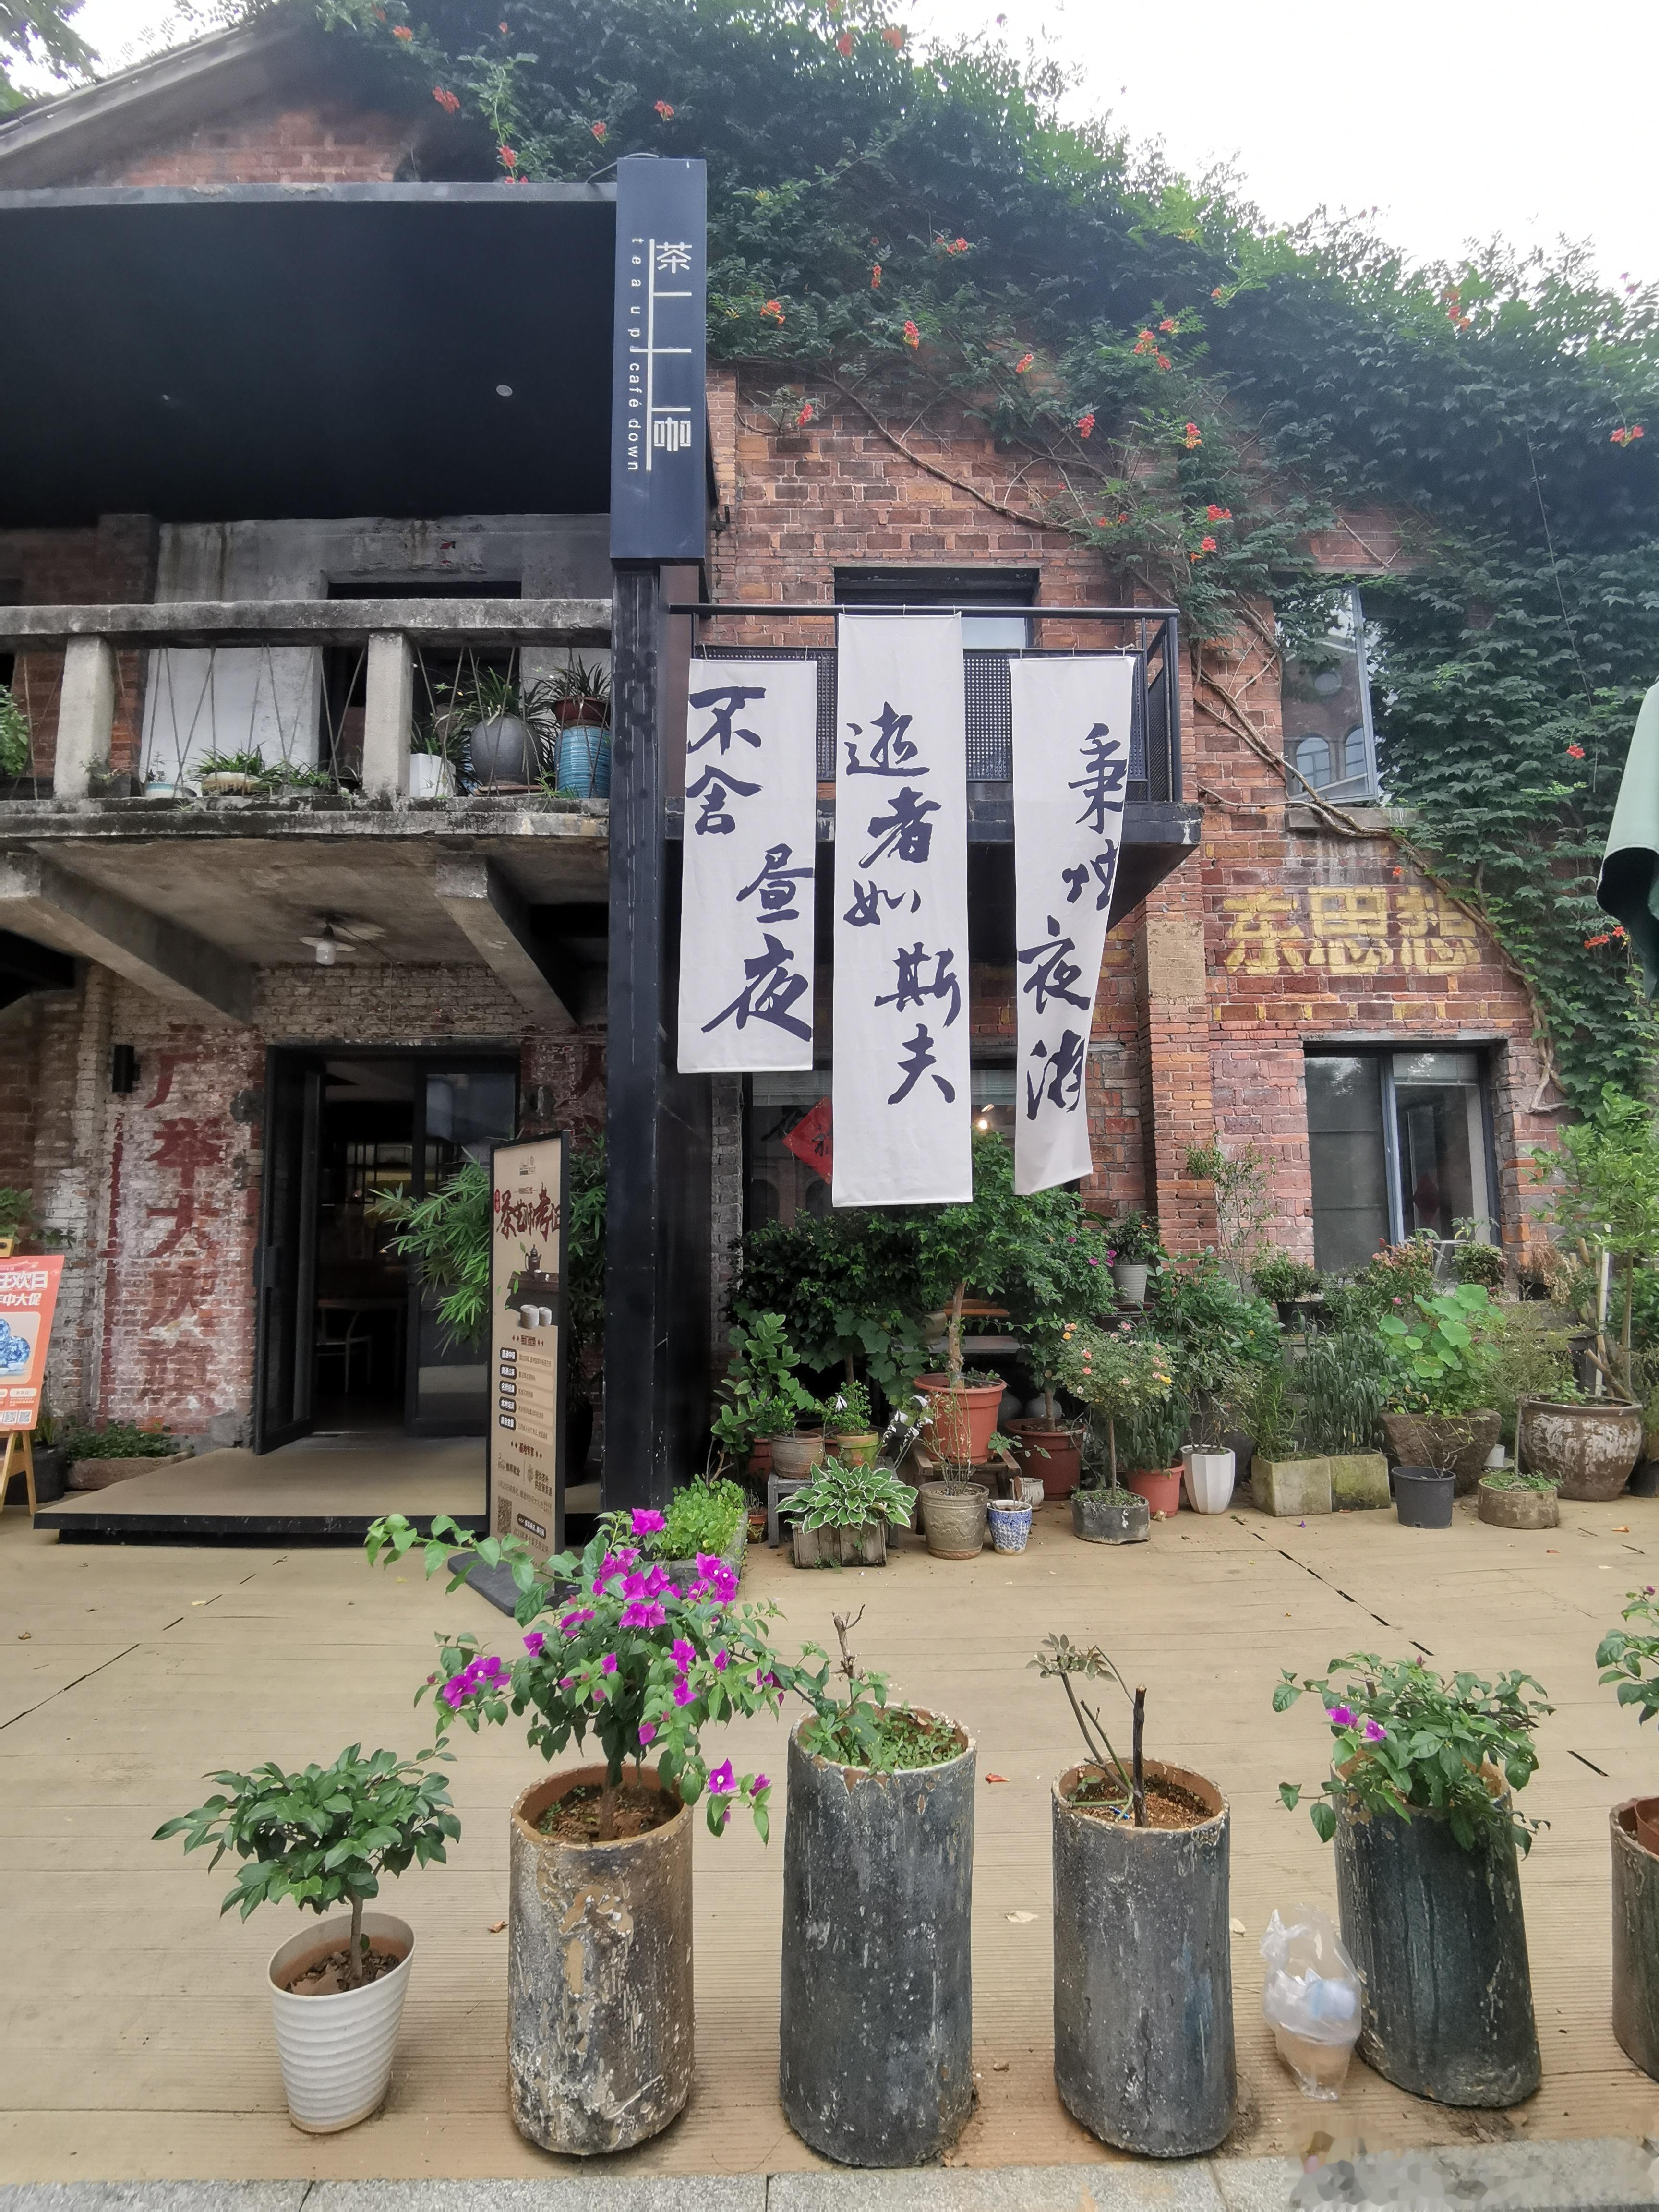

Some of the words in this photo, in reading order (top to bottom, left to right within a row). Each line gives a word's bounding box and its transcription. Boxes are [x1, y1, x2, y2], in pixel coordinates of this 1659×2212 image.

[631, 238, 644, 287] tea
[628, 306, 641, 339] up
[629, 363, 643, 407] café
[627, 418, 642, 470] down
[843, 701, 961, 1105] 逝者如斯夫
[0, 1292, 42, 1306] 中大促
